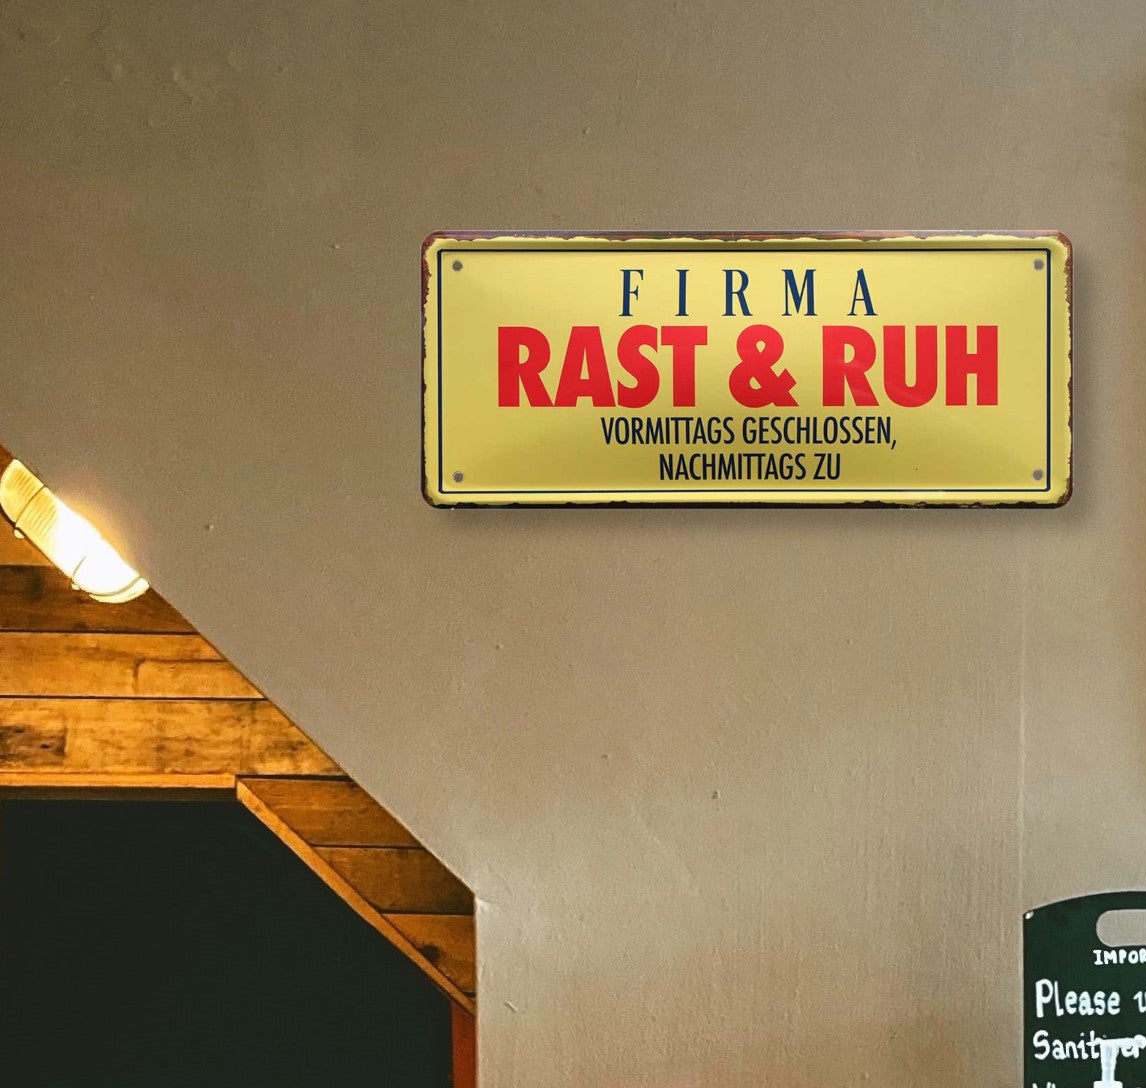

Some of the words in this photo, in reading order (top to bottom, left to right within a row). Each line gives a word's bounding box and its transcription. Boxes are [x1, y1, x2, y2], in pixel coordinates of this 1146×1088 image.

[619, 269, 878, 317] FIRMA
[498, 324, 708, 407] RAST
[729, 323, 800, 408] &
[822, 325, 998, 407] RUH
[600, 416, 735, 445] VORMITTAGS
[742, 416, 897, 450] GESCHLOSSEN,
[659, 453, 806, 480] NACHMITTAGS
[813, 453, 841, 480] ZU
[1035, 978, 1121, 1018] Please
[1033, 1030, 1145, 1060] Saniter
